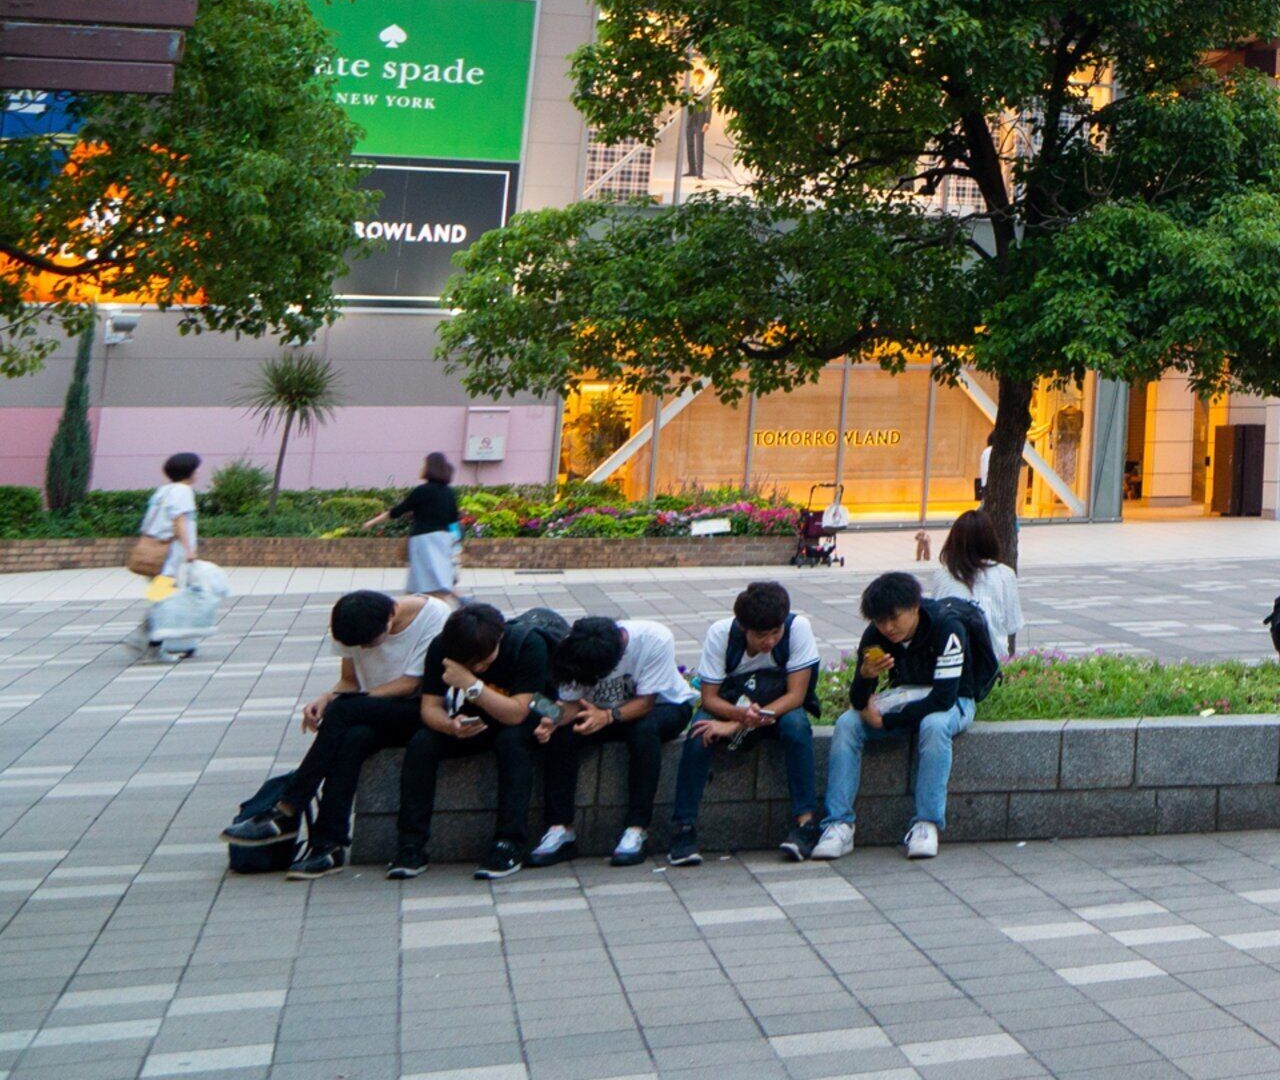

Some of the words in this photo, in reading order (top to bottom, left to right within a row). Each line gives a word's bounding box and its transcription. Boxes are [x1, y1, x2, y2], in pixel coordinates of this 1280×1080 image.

[313, 56, 370, 78] ate
[382, 58, 484, 89] spade
[336, 92, 378, 106] NEW
[385, 95, 436, 109] YORK
